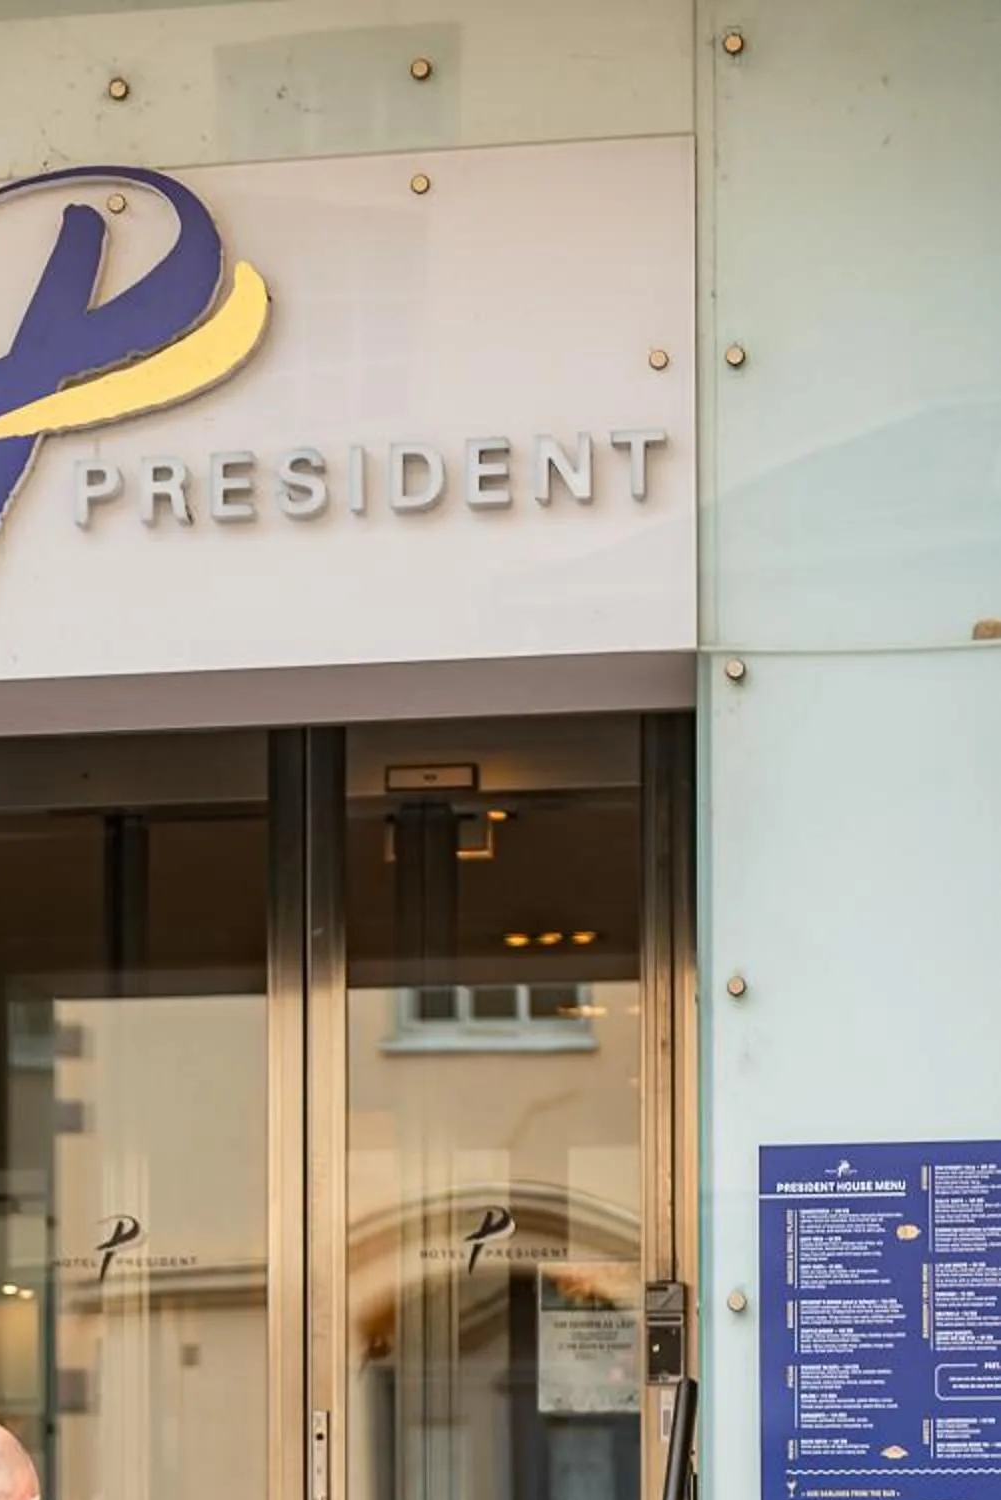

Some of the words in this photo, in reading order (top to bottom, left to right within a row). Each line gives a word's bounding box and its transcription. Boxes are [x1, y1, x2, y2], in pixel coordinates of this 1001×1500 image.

[73, 429, 666, 529] PRESIDENT
[776, 1182, 835, 1193] PRESIDENT
[836, 1181, 873, 1192] HOUSE
[874, 1180, 906, 1191] MENU
[420, 1249, 466, 1261] HOTEL
[485, 1247, 568, 1260] PRESIDENT
[52, 1256, 97, 1269] HOTEL
[115, 1255, 198, 1268] PRESIDENT
